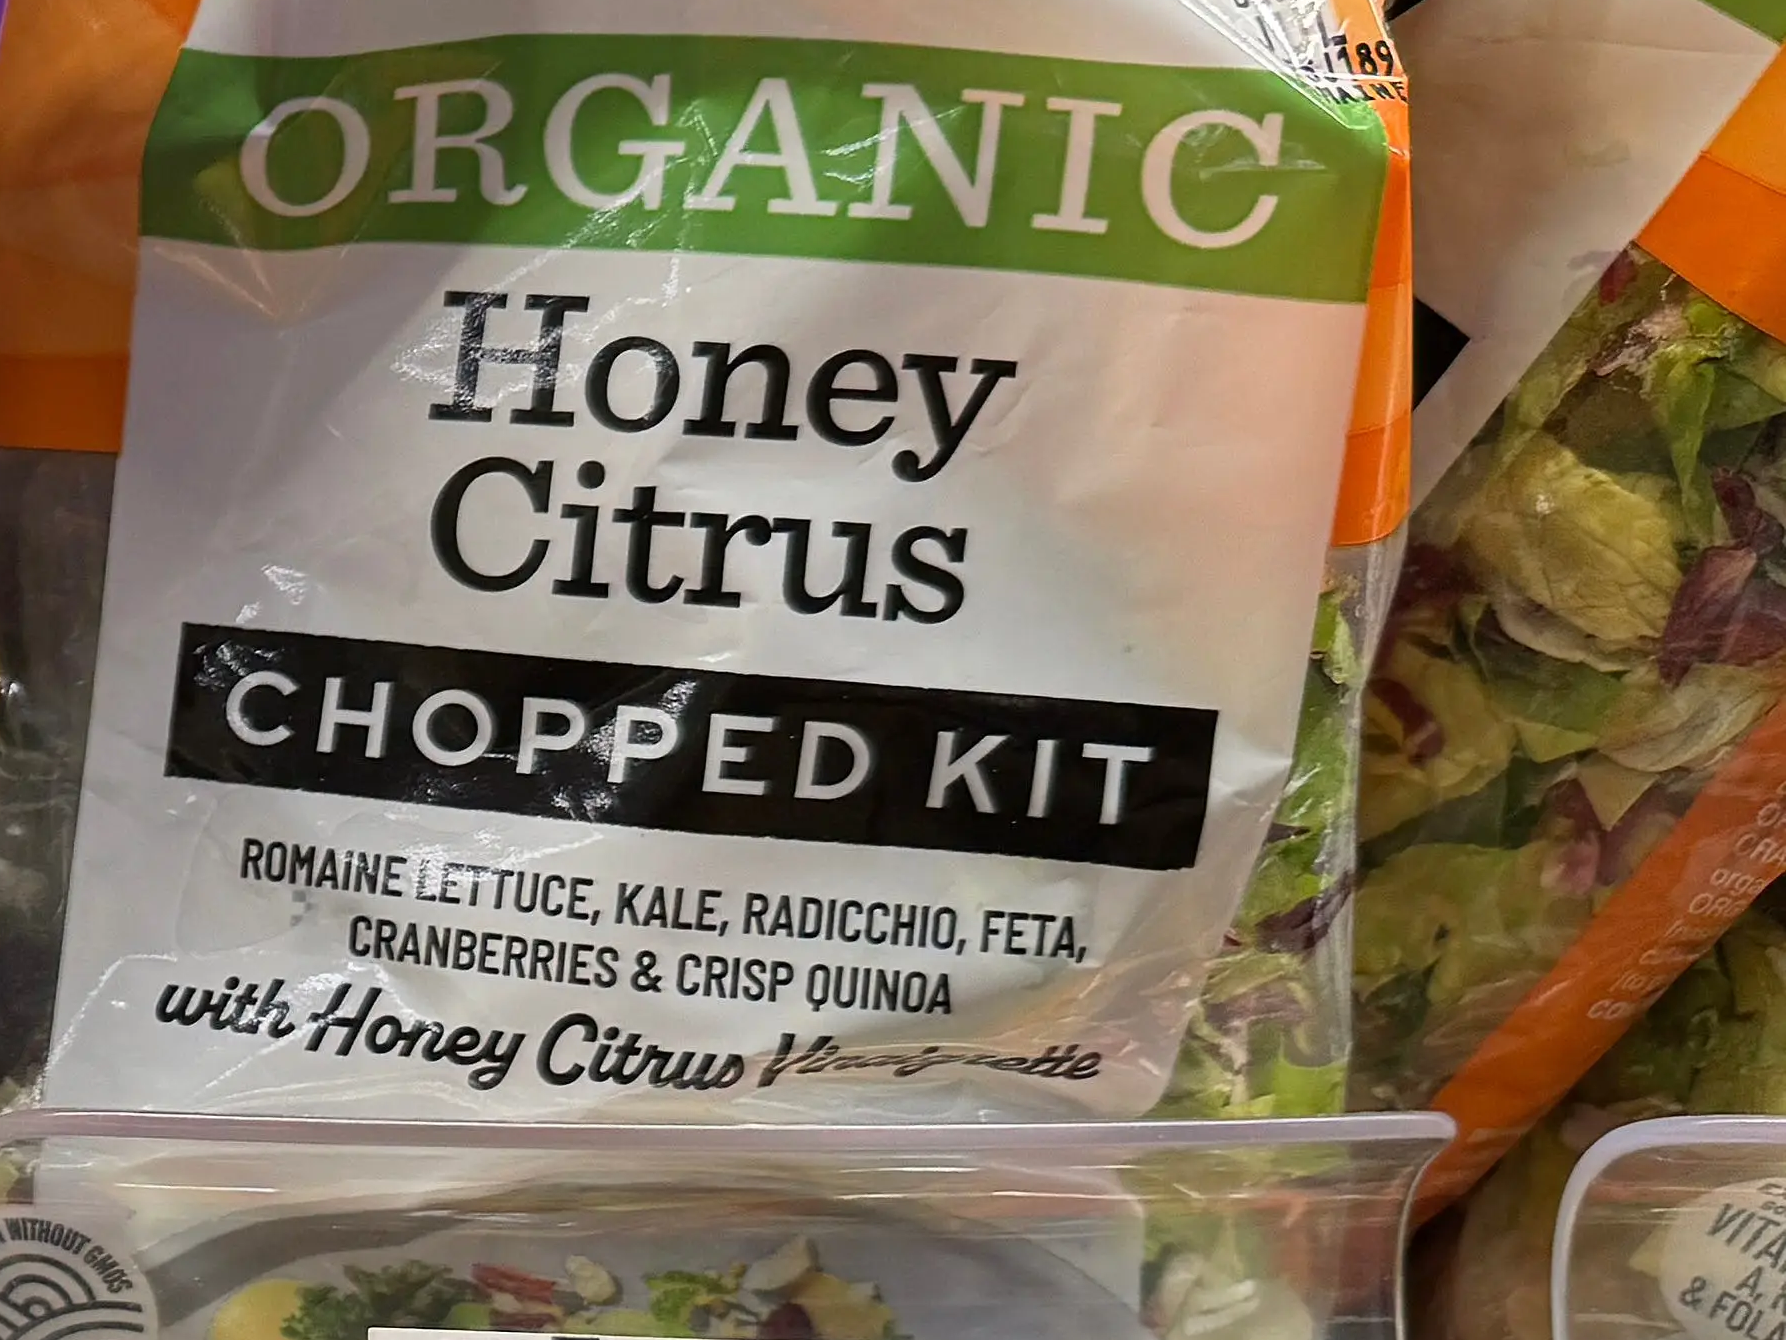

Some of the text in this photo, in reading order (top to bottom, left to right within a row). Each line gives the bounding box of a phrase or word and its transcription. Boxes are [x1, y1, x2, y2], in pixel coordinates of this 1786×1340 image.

[239, 73, 1284, 251] ORGANIC
[428, 292, 1017, 481] Honey
[430, 455, 970, 623] Citrus
[226, 666, 1156, 827] CHOPPED KIT
[241, 838, 1088, 963] ROMAINE LETTUCE, KALE, RADICCHIO, FETA,
[348, 916, 953, 1014] CRANBERRIES & CRISP QUINOA
[156, 976, 747, 1092] with Honey Citrus
[5, 1217, 91, 1255] WITHOUT
